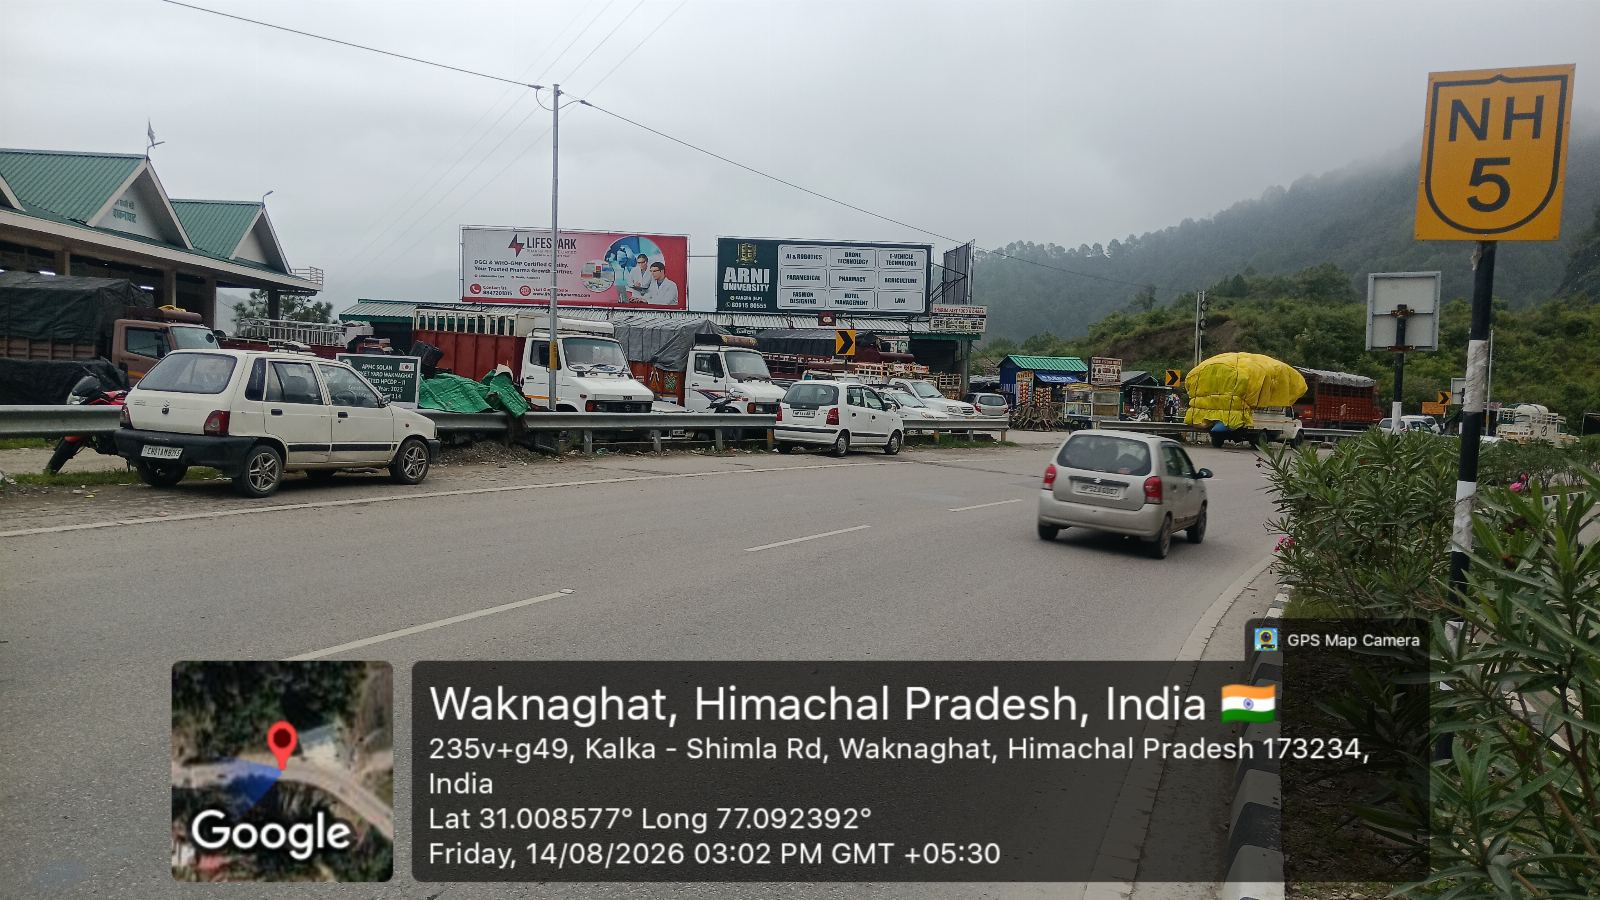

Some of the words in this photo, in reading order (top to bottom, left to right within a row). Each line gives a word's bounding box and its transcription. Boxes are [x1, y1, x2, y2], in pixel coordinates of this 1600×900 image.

[1449, 95, 1544, 141] NH
[1467, 157, 1510, 212] 5
[526, 236, 577, 250] LIFESARK
[723, 266, 770, 284] ARNI
[722, 282, 770, 292] UNIVERSITY
